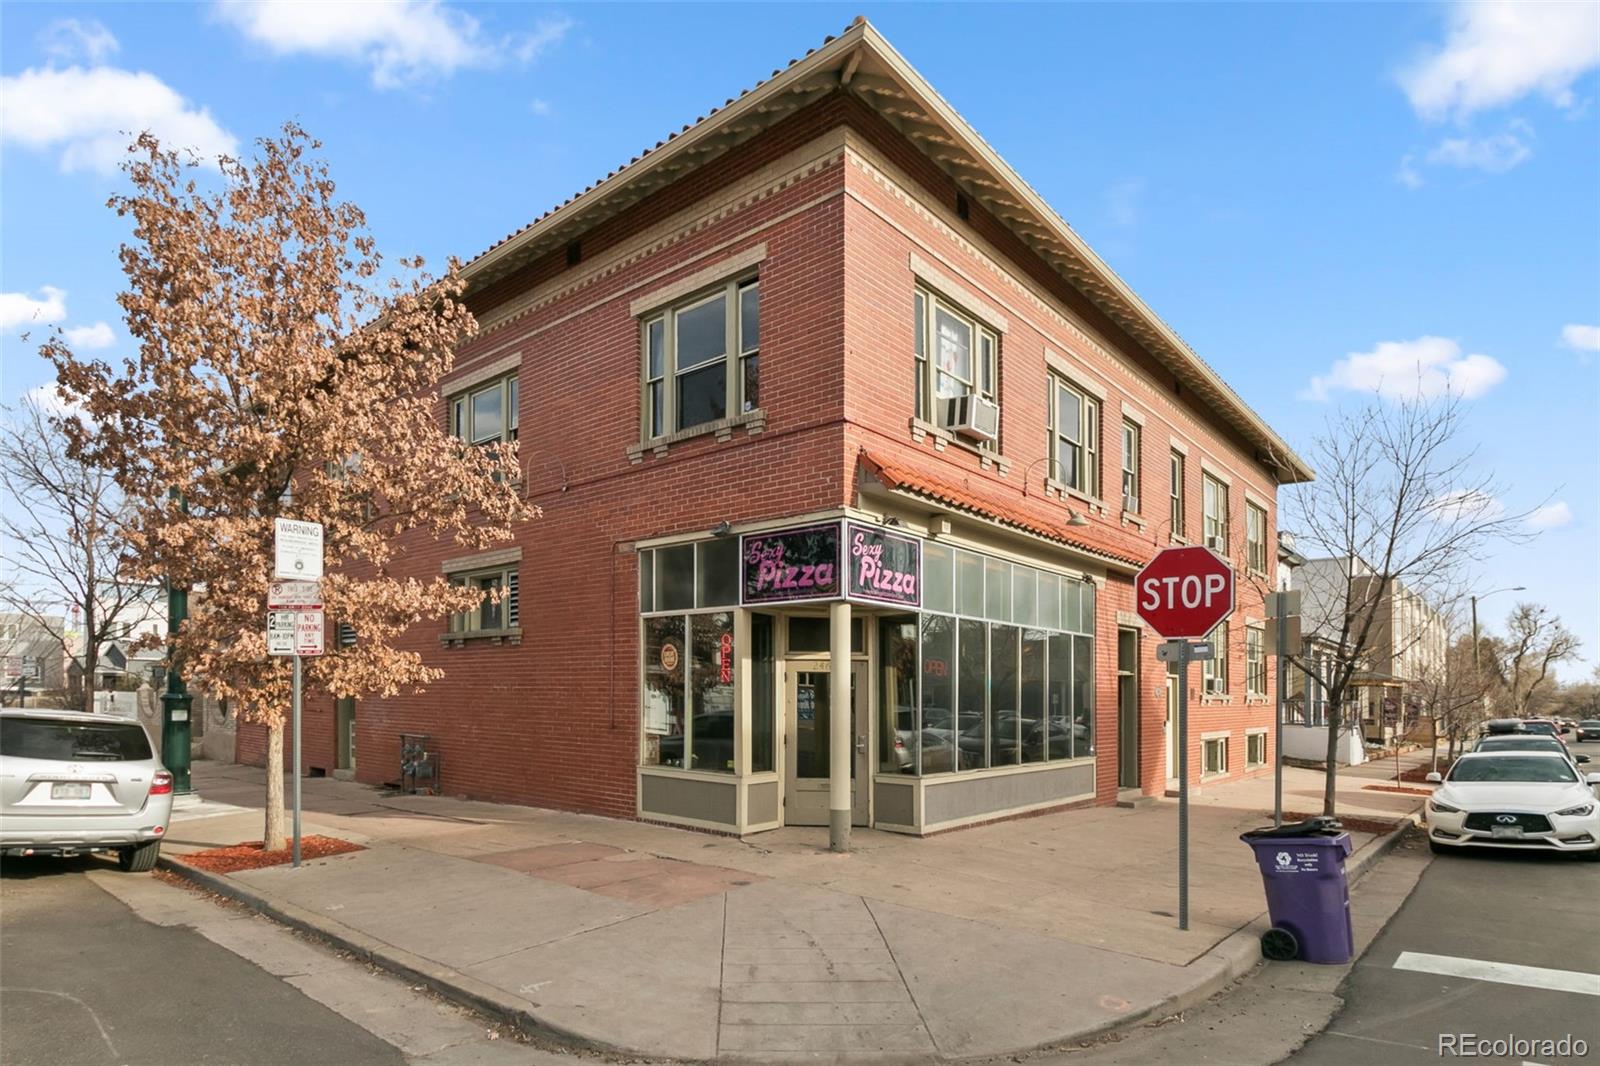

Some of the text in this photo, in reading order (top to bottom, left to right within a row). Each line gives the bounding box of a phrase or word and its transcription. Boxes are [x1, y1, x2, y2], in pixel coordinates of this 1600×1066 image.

[280, 523, 319, 537] WARNING
[748, 541, 785, 564] Sexy
[852, 532, 883, 561] Sexy
[757, 560, 834, 591] Pizza
[859, 555, 915, 595] Pizza
[1142, 574, 1226, 611] STOP
[297, 624, 321, 632] PARKING
[304, 614, 315, 622] NO
[720, 633, 732, 684] OPEN
